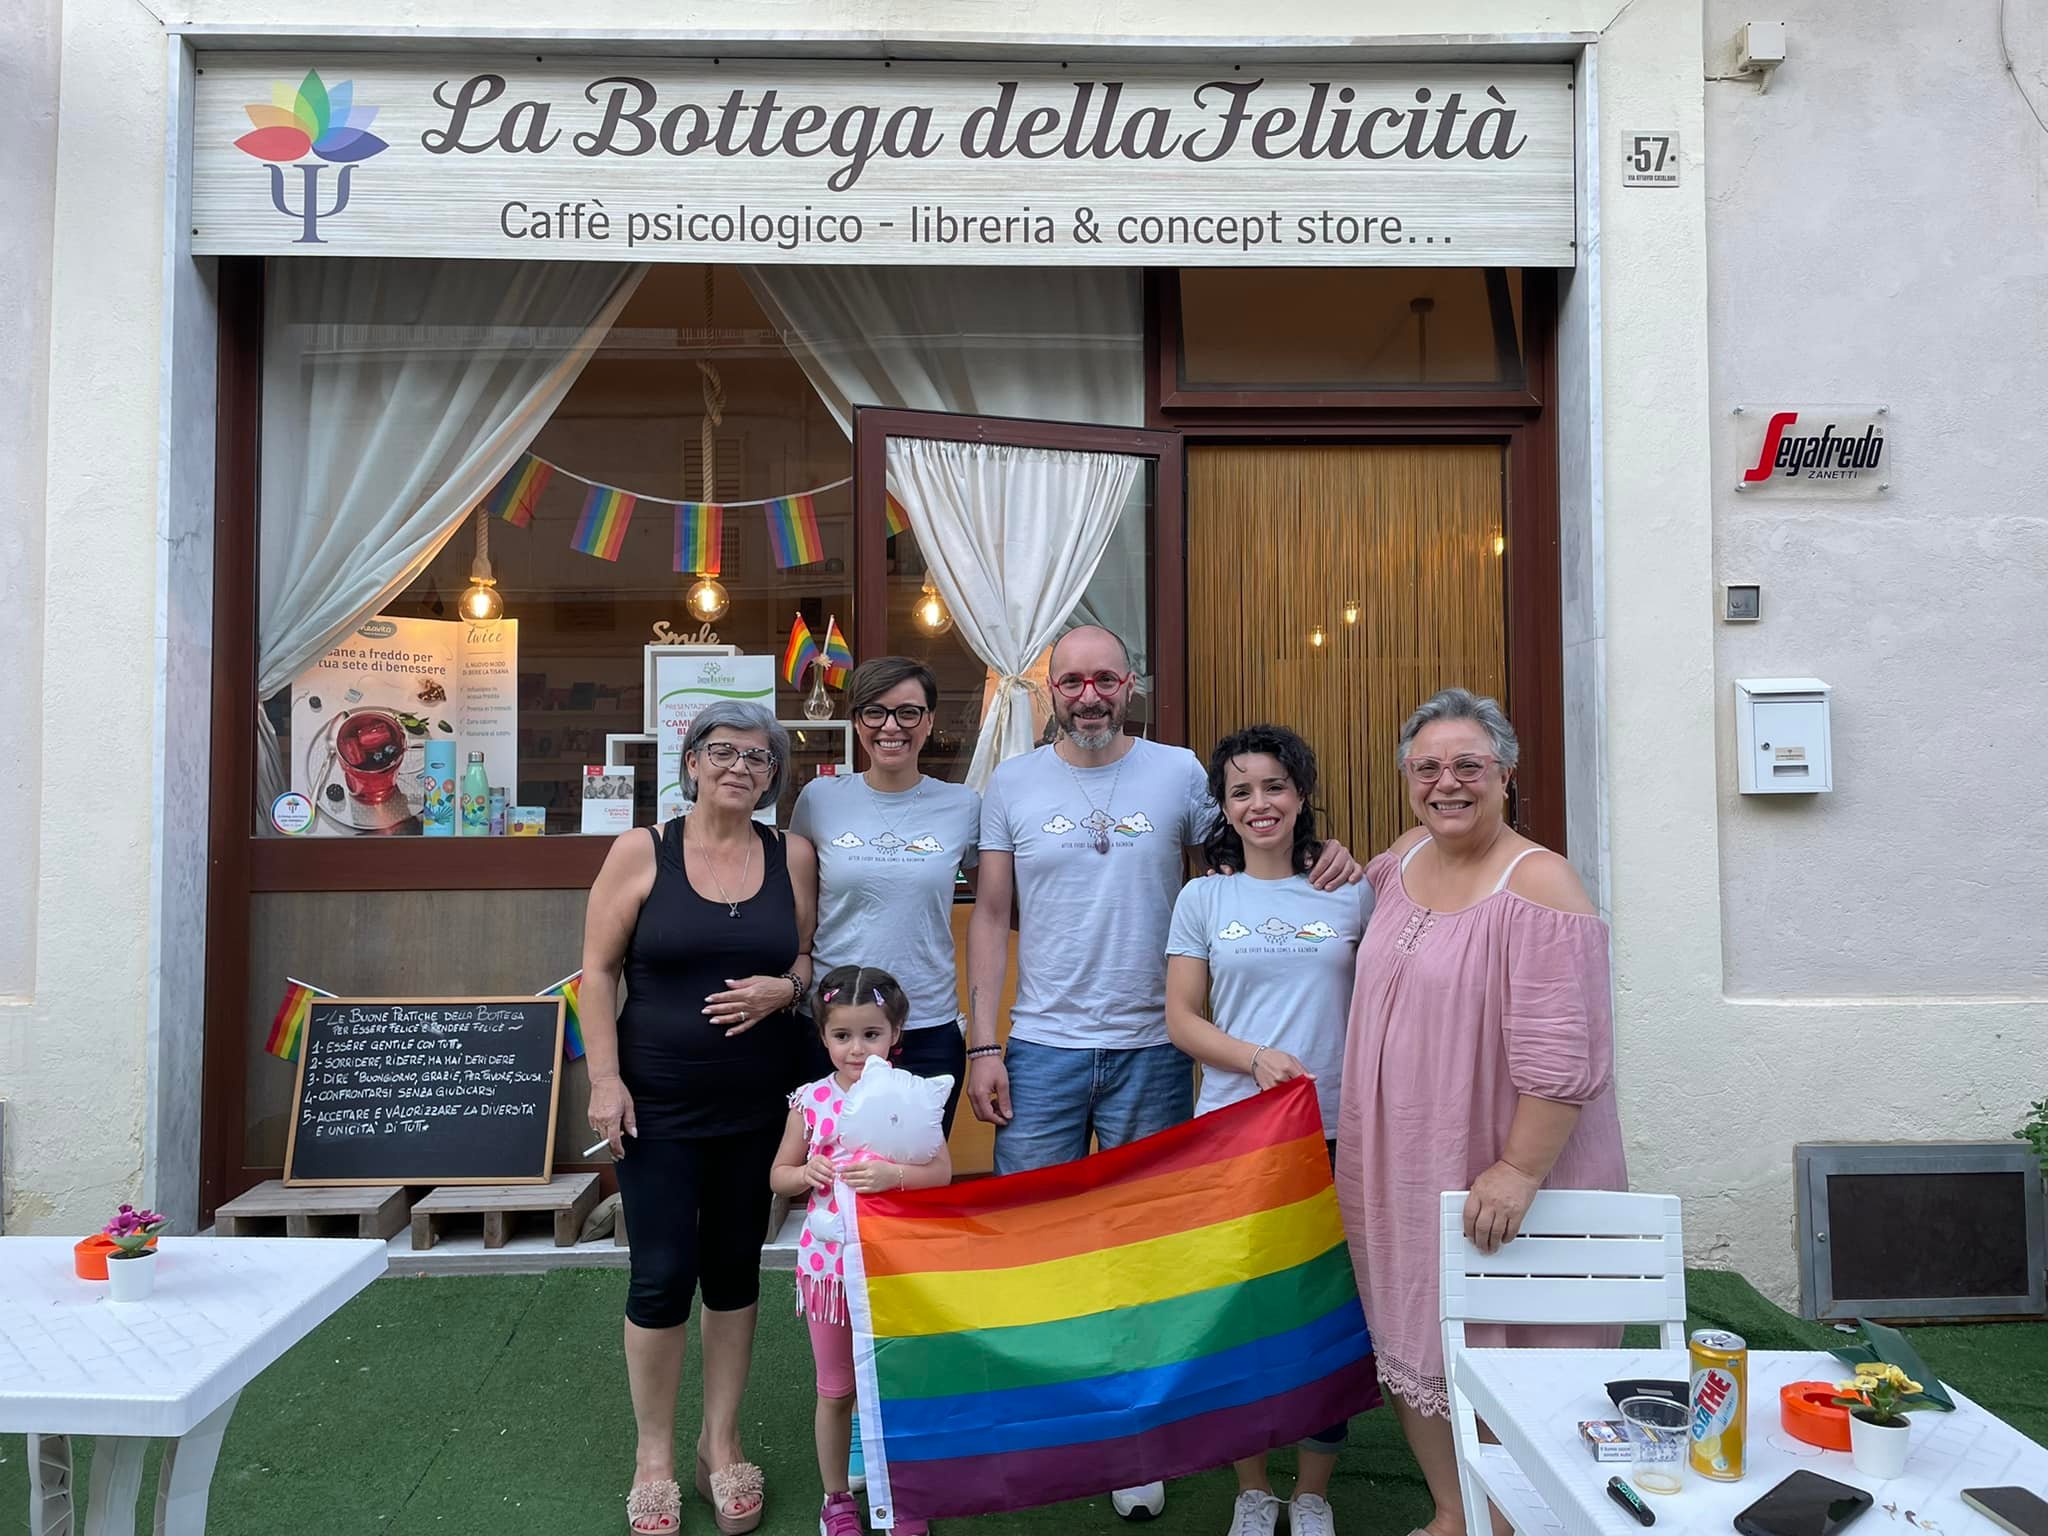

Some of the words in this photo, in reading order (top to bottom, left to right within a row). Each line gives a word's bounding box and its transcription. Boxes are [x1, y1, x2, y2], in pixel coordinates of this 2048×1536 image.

[421, 74, 562, 155] La
[572, 76, 944, 192] Bottega
[959, 81, 1181, 160] della
[1180, 78, 1528, 162] Felicità
[1634, 136, 1669, 172] 57
[500, 199, 612, 242] Caffè
[628, 202, 863, 250] psicologico
[912, 206, 1055, 244] libreria
[1073, 206, 1102, 245] &
[1116, 207, 1281, 250] concept
[1297, 209, 1452, 245] store...
[1744, 412, 1884, 481] Segafredo
[1808, 470, 1858, 479] ZANETTI
[650, 620, 721, 645] Smile
[370, 648, 410, 660] freddo
[413, 653, 433, 664] per
[342, 660, 368, 670] sete
[371, 660, 382, 671] di
[386, 662, 446, 675] benessere
[349, 1007, 390, 1023] BUONE
[391, 1005, 438, 1021] PRATICHE
[444, 1010, 473, 1021] DELLA
[476, 1004, 525, 1021] BOTTEGA
[332, 1023, 349, 1035] PER
[352, 1023, 388, 1035] ESSERE
[388, 1022, 420, 1033] FELICE
[471, 1021, 505, 1033] FELICE
[326, 1040, 367, 1053] ESSERE
[370, 1038, 415, 1050] GENTILE
[417, 1039, 436, 1050] CON
[427, 1054, 442, 1065] MA
[444, 1052, 463, 1065] MAI
[464, 1054, 516, 1065] DERIDERE
[323, 1071, 349, 1085] DIRE
[463, 1069, 481, 1081] PER
[318, 1086, 392, 1101] CONFRONTARSI
[397, 1087, 433, 1099] SENZA
[435, 1084, 498, 1097] GIUDICARSI
[316, 1108, 371, 1123] ACCETTARE
[374, 1106, 383, 1120] E
[385, 1103, 463, 1119] VALORIZZARE
[463, 1105, 479, 1116] LA
[316, 1125, 325, 1137] E
[383, 1120, 398, 1134] DI
